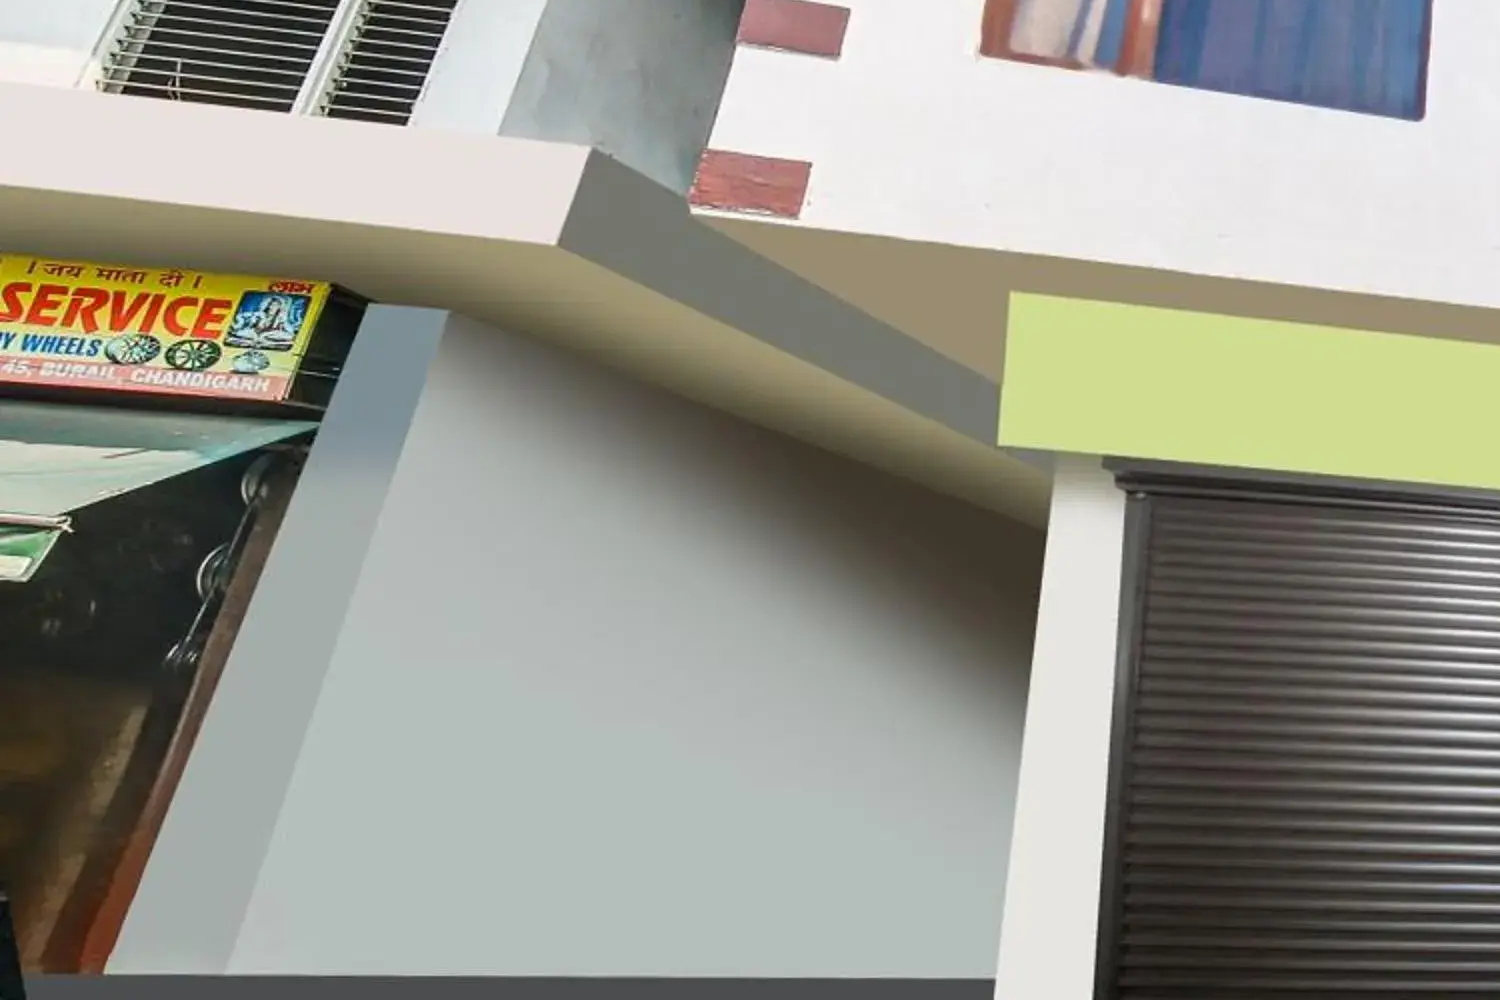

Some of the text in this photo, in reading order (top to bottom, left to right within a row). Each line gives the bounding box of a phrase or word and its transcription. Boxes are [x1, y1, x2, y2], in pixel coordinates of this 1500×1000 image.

[0, 281, 233, 340] SERVICE
[21, 333, 103, 357] WHEELS
[130, 367, 270, 393] CHANDIGARH
